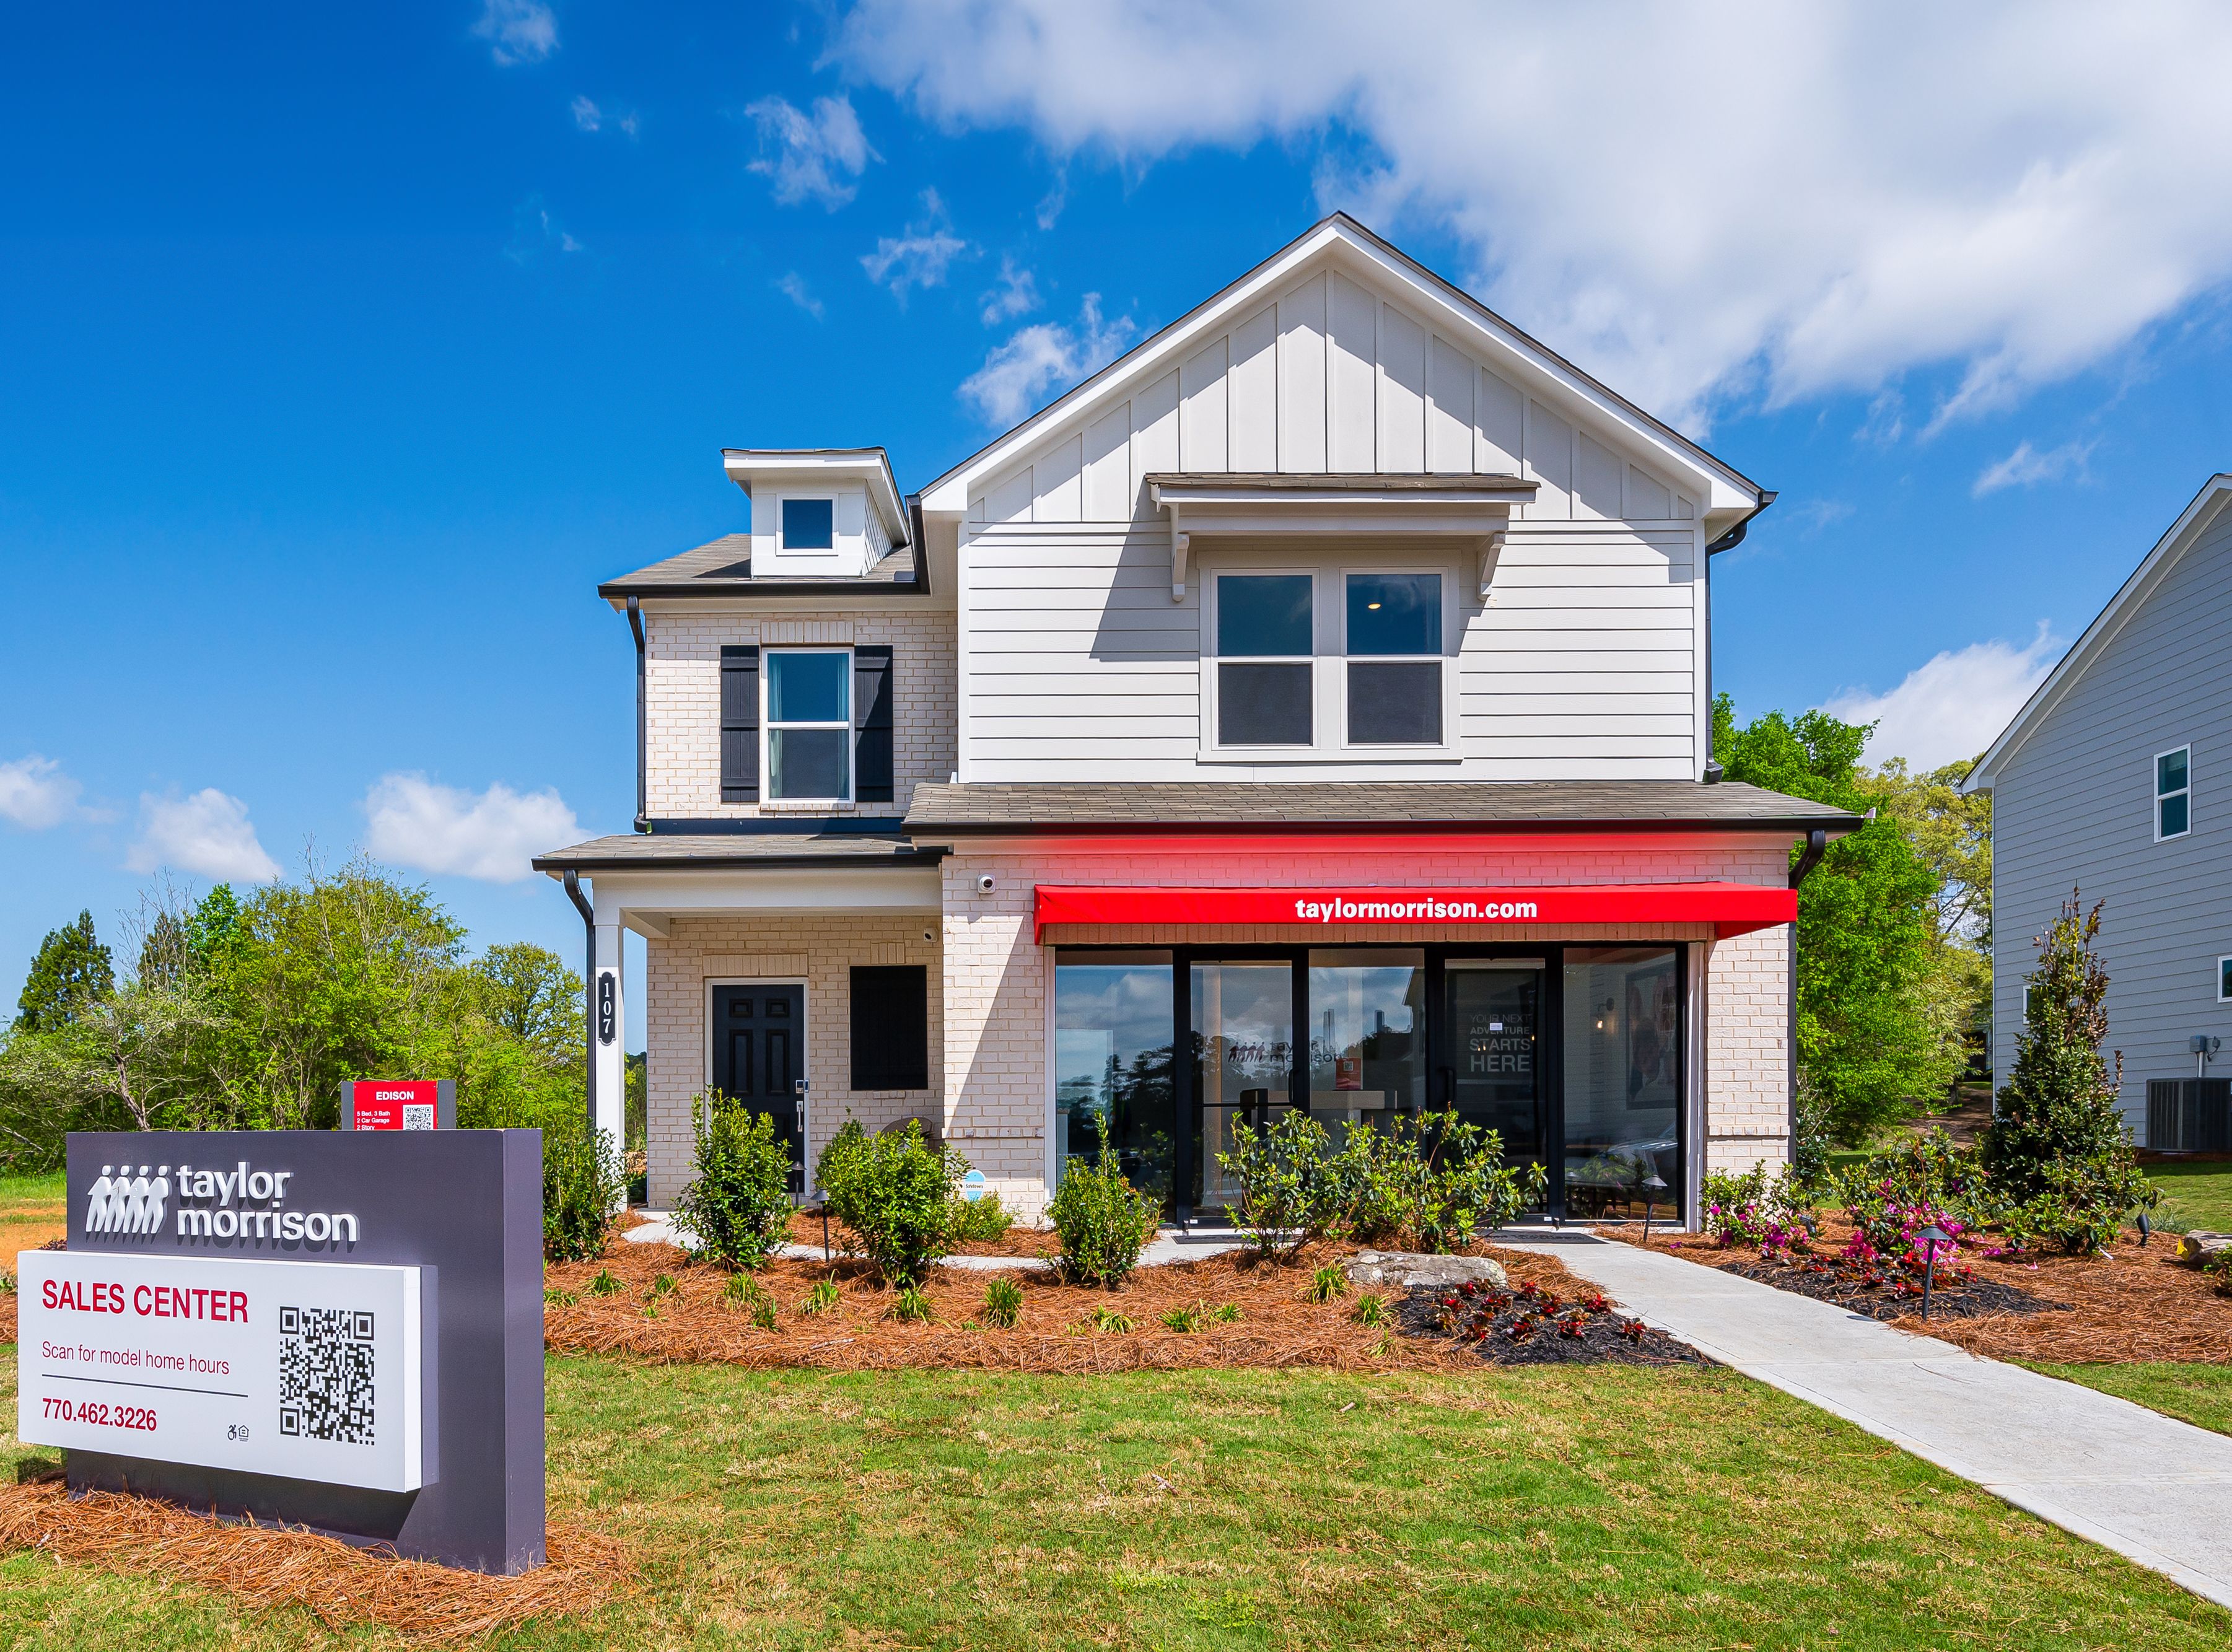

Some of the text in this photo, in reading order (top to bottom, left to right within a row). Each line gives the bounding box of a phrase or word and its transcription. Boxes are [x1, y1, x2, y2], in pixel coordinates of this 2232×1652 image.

[1295, 898, 1538, 922] taylormorrison.com
[603, 982, 611, 1034] 107
[1470, 1014, 1532, 1023] YOUR NEXT
[1469, 1038, 1531, 1051] STARTS
[1471, 1055, 1530, 1072] HERE
[375, 1091, 414, 1101] EDISON
[175, 1161, 292, 1206] taylor
[177, 1201, 357, 1242] morrison
[42, 1279, 248, 1323] SALES CENTER
[42, 1341, 230, 1375] Scan for model home hours
[42, 1397, 157, 1431] 770.462.3226
